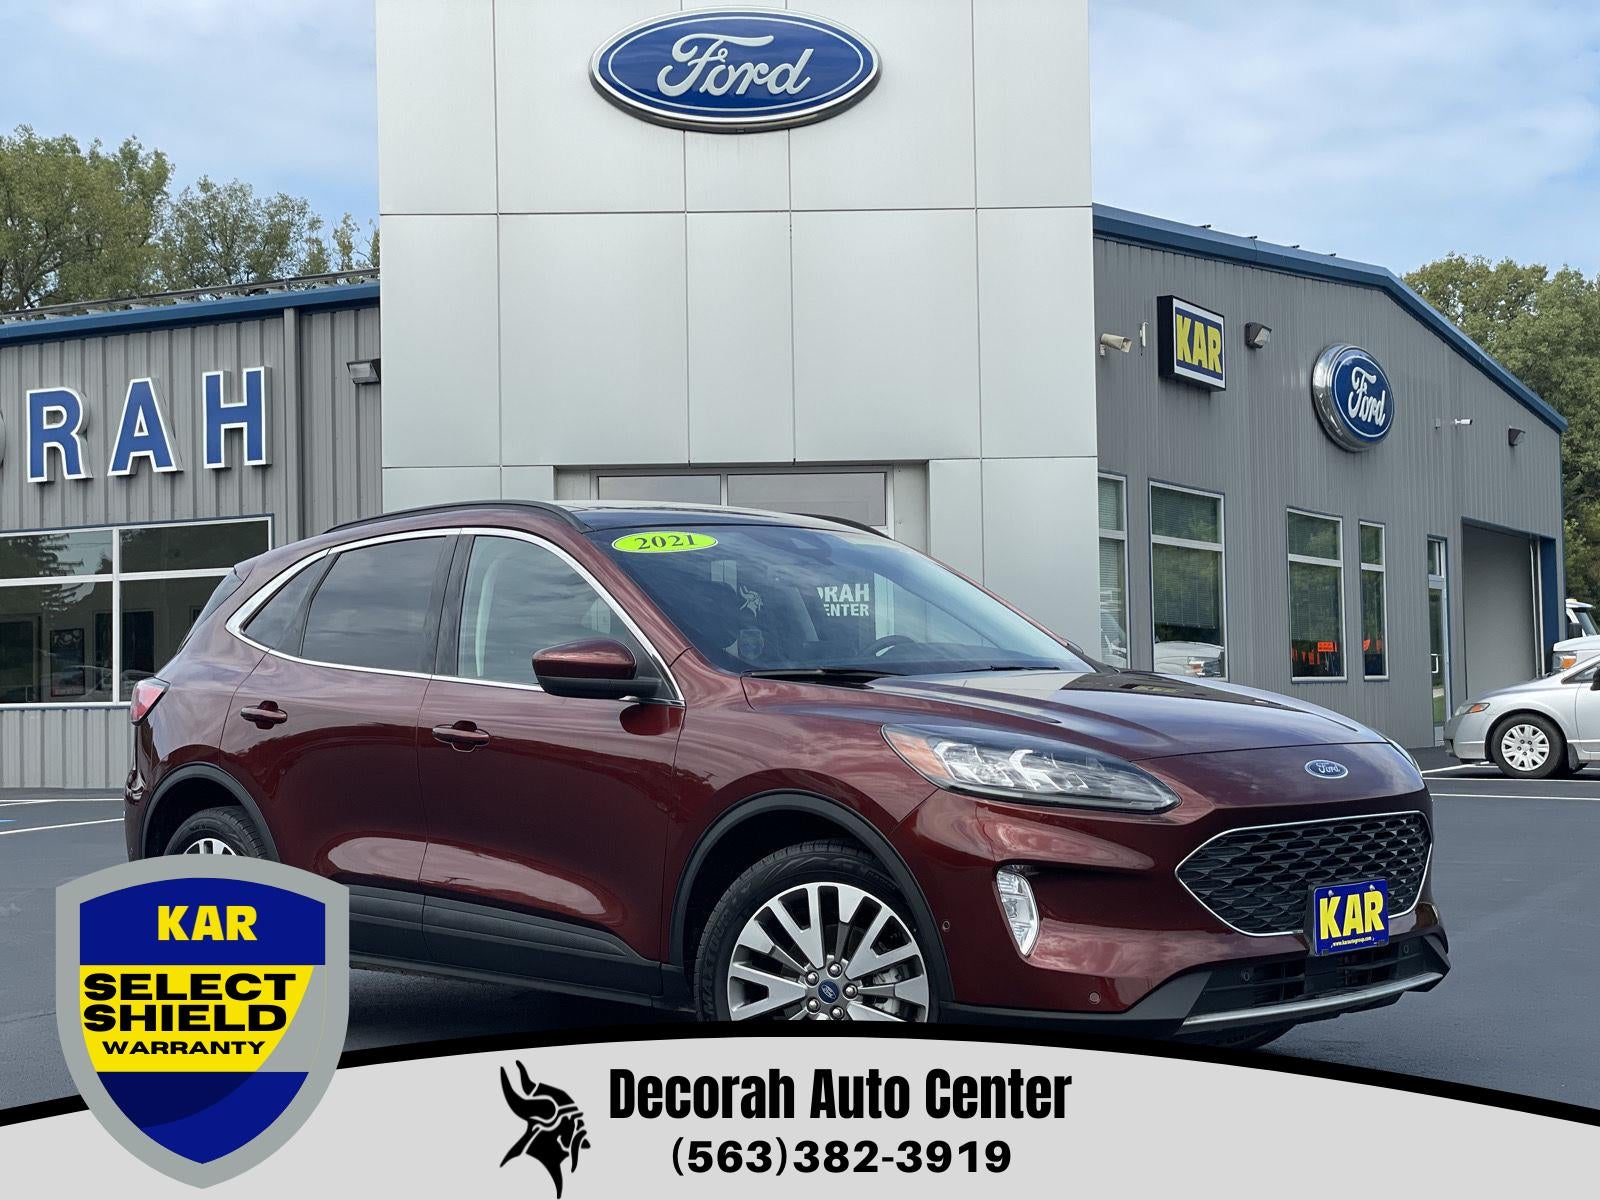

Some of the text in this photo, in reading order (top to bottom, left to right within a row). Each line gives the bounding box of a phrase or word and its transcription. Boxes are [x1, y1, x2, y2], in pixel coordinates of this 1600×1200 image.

[656, 33, 814, 97] Ford
[1176, 314, 1223, 374] KAR
[0, 365, 269, 483] RAH
[1348, 366, 1386, 427] Ford
[634, 533, 697, 551] 2021
[1315, 762, 1341, 774] Ford
[1319, 890, 1385, 940] KAR
